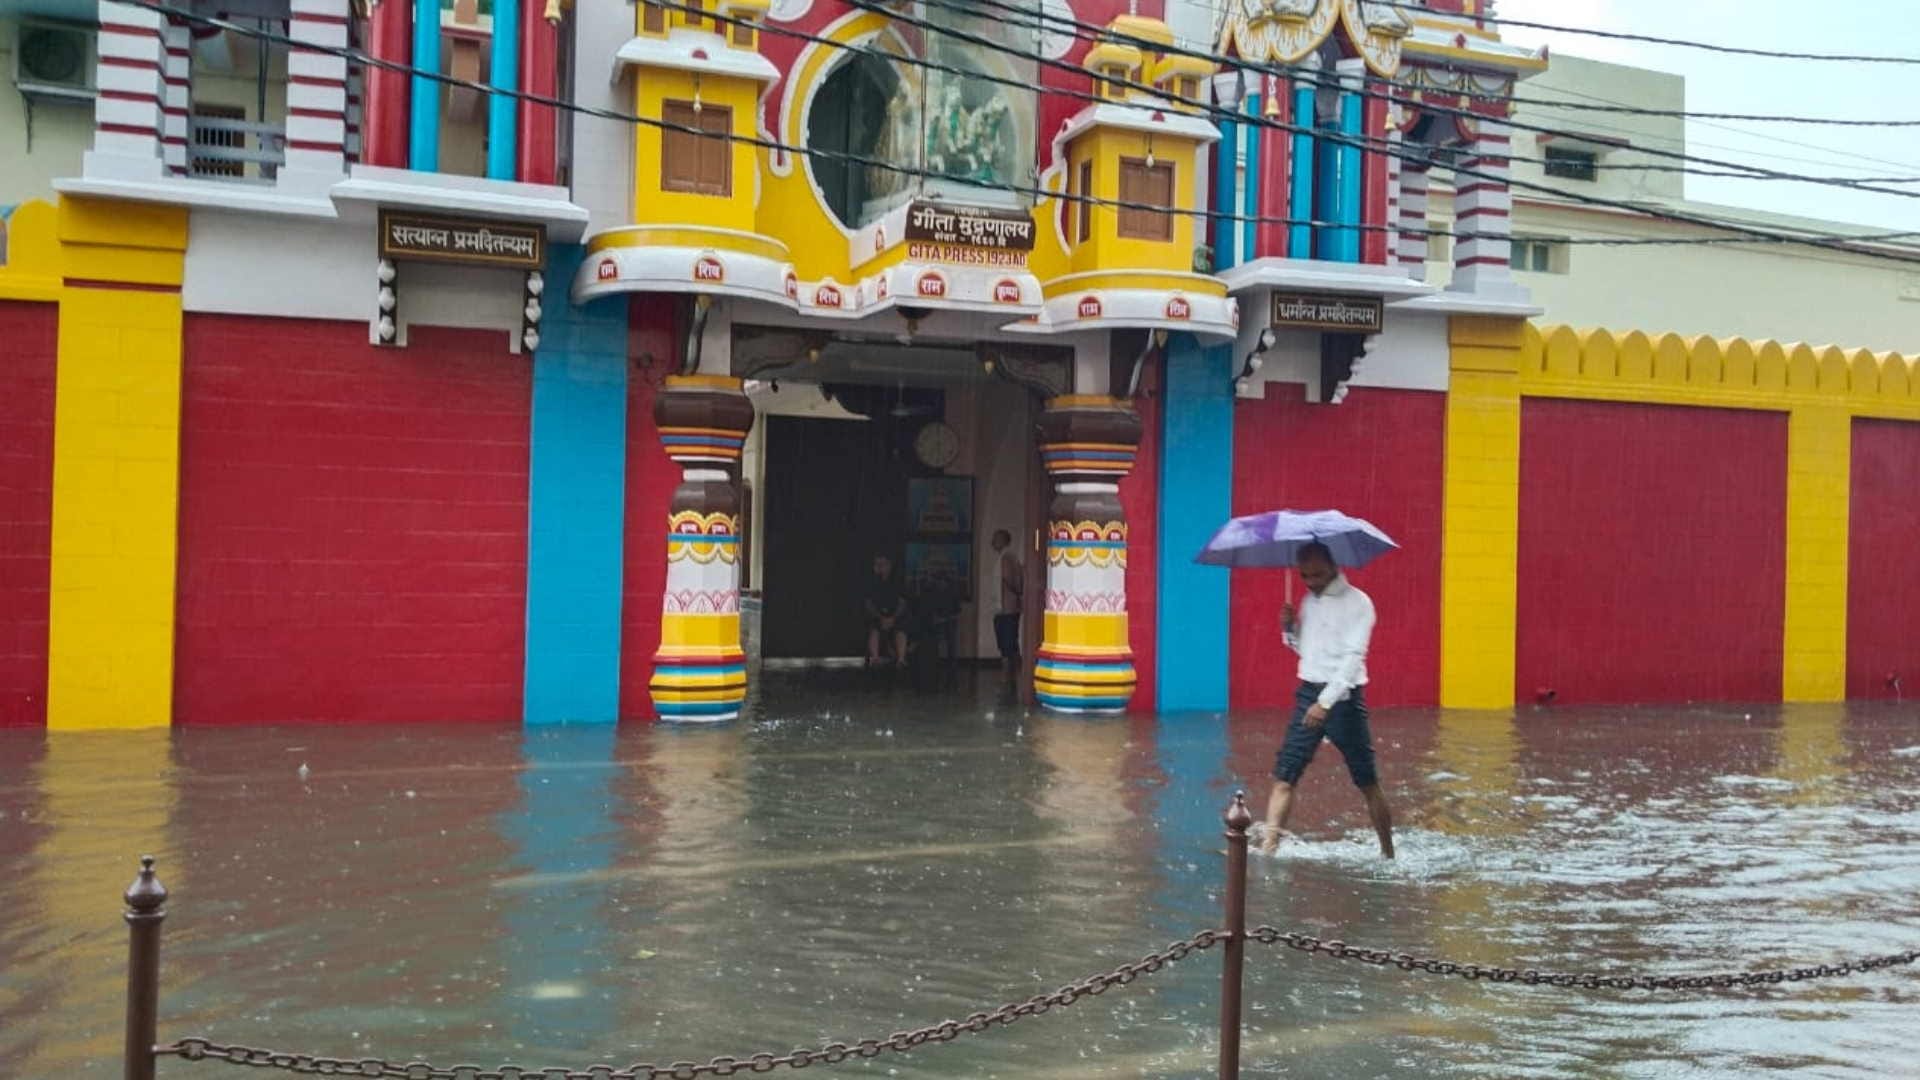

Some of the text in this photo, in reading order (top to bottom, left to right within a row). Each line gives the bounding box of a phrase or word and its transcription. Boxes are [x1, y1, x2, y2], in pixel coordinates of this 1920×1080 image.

[914, 208, 954, 231] गीता
[958, 216, 1031, 239] मुद्रणालय
[909, 243, 941, 260] GITA
[945, 246, 985, 264] PRESS
[921, 278, 942, 294] राम
